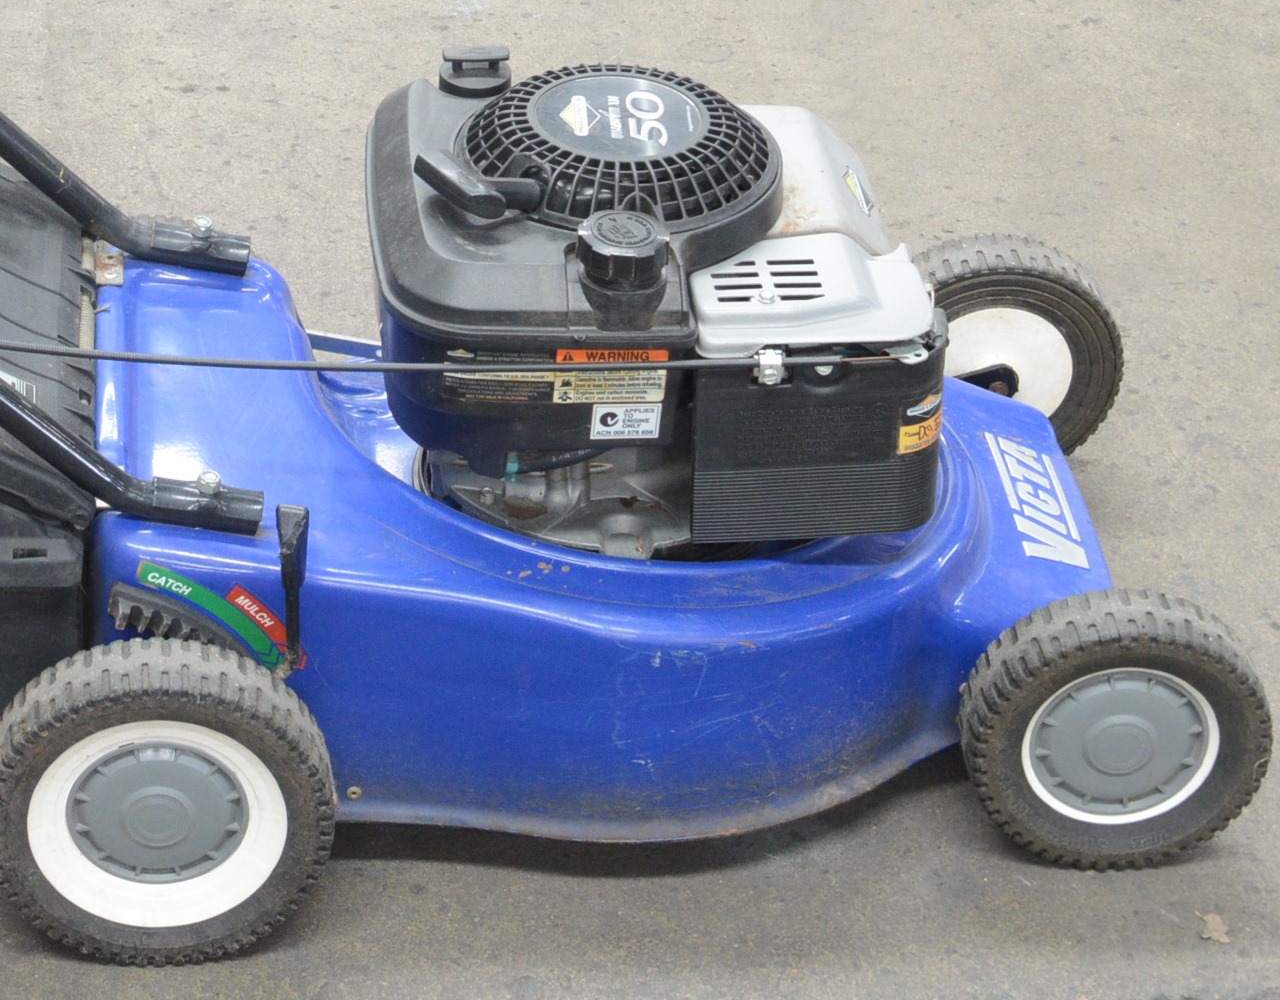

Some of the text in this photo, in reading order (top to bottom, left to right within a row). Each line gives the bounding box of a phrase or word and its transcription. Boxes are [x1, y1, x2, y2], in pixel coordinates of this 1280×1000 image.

[625, 91, 668, 146] 50
[586, 351, 650, 362] WARNING
[991, 434, 1090, 570] VICTA
[147, 572, 193, 596] CATCH
[234, 595, 275, 628] MULCH
